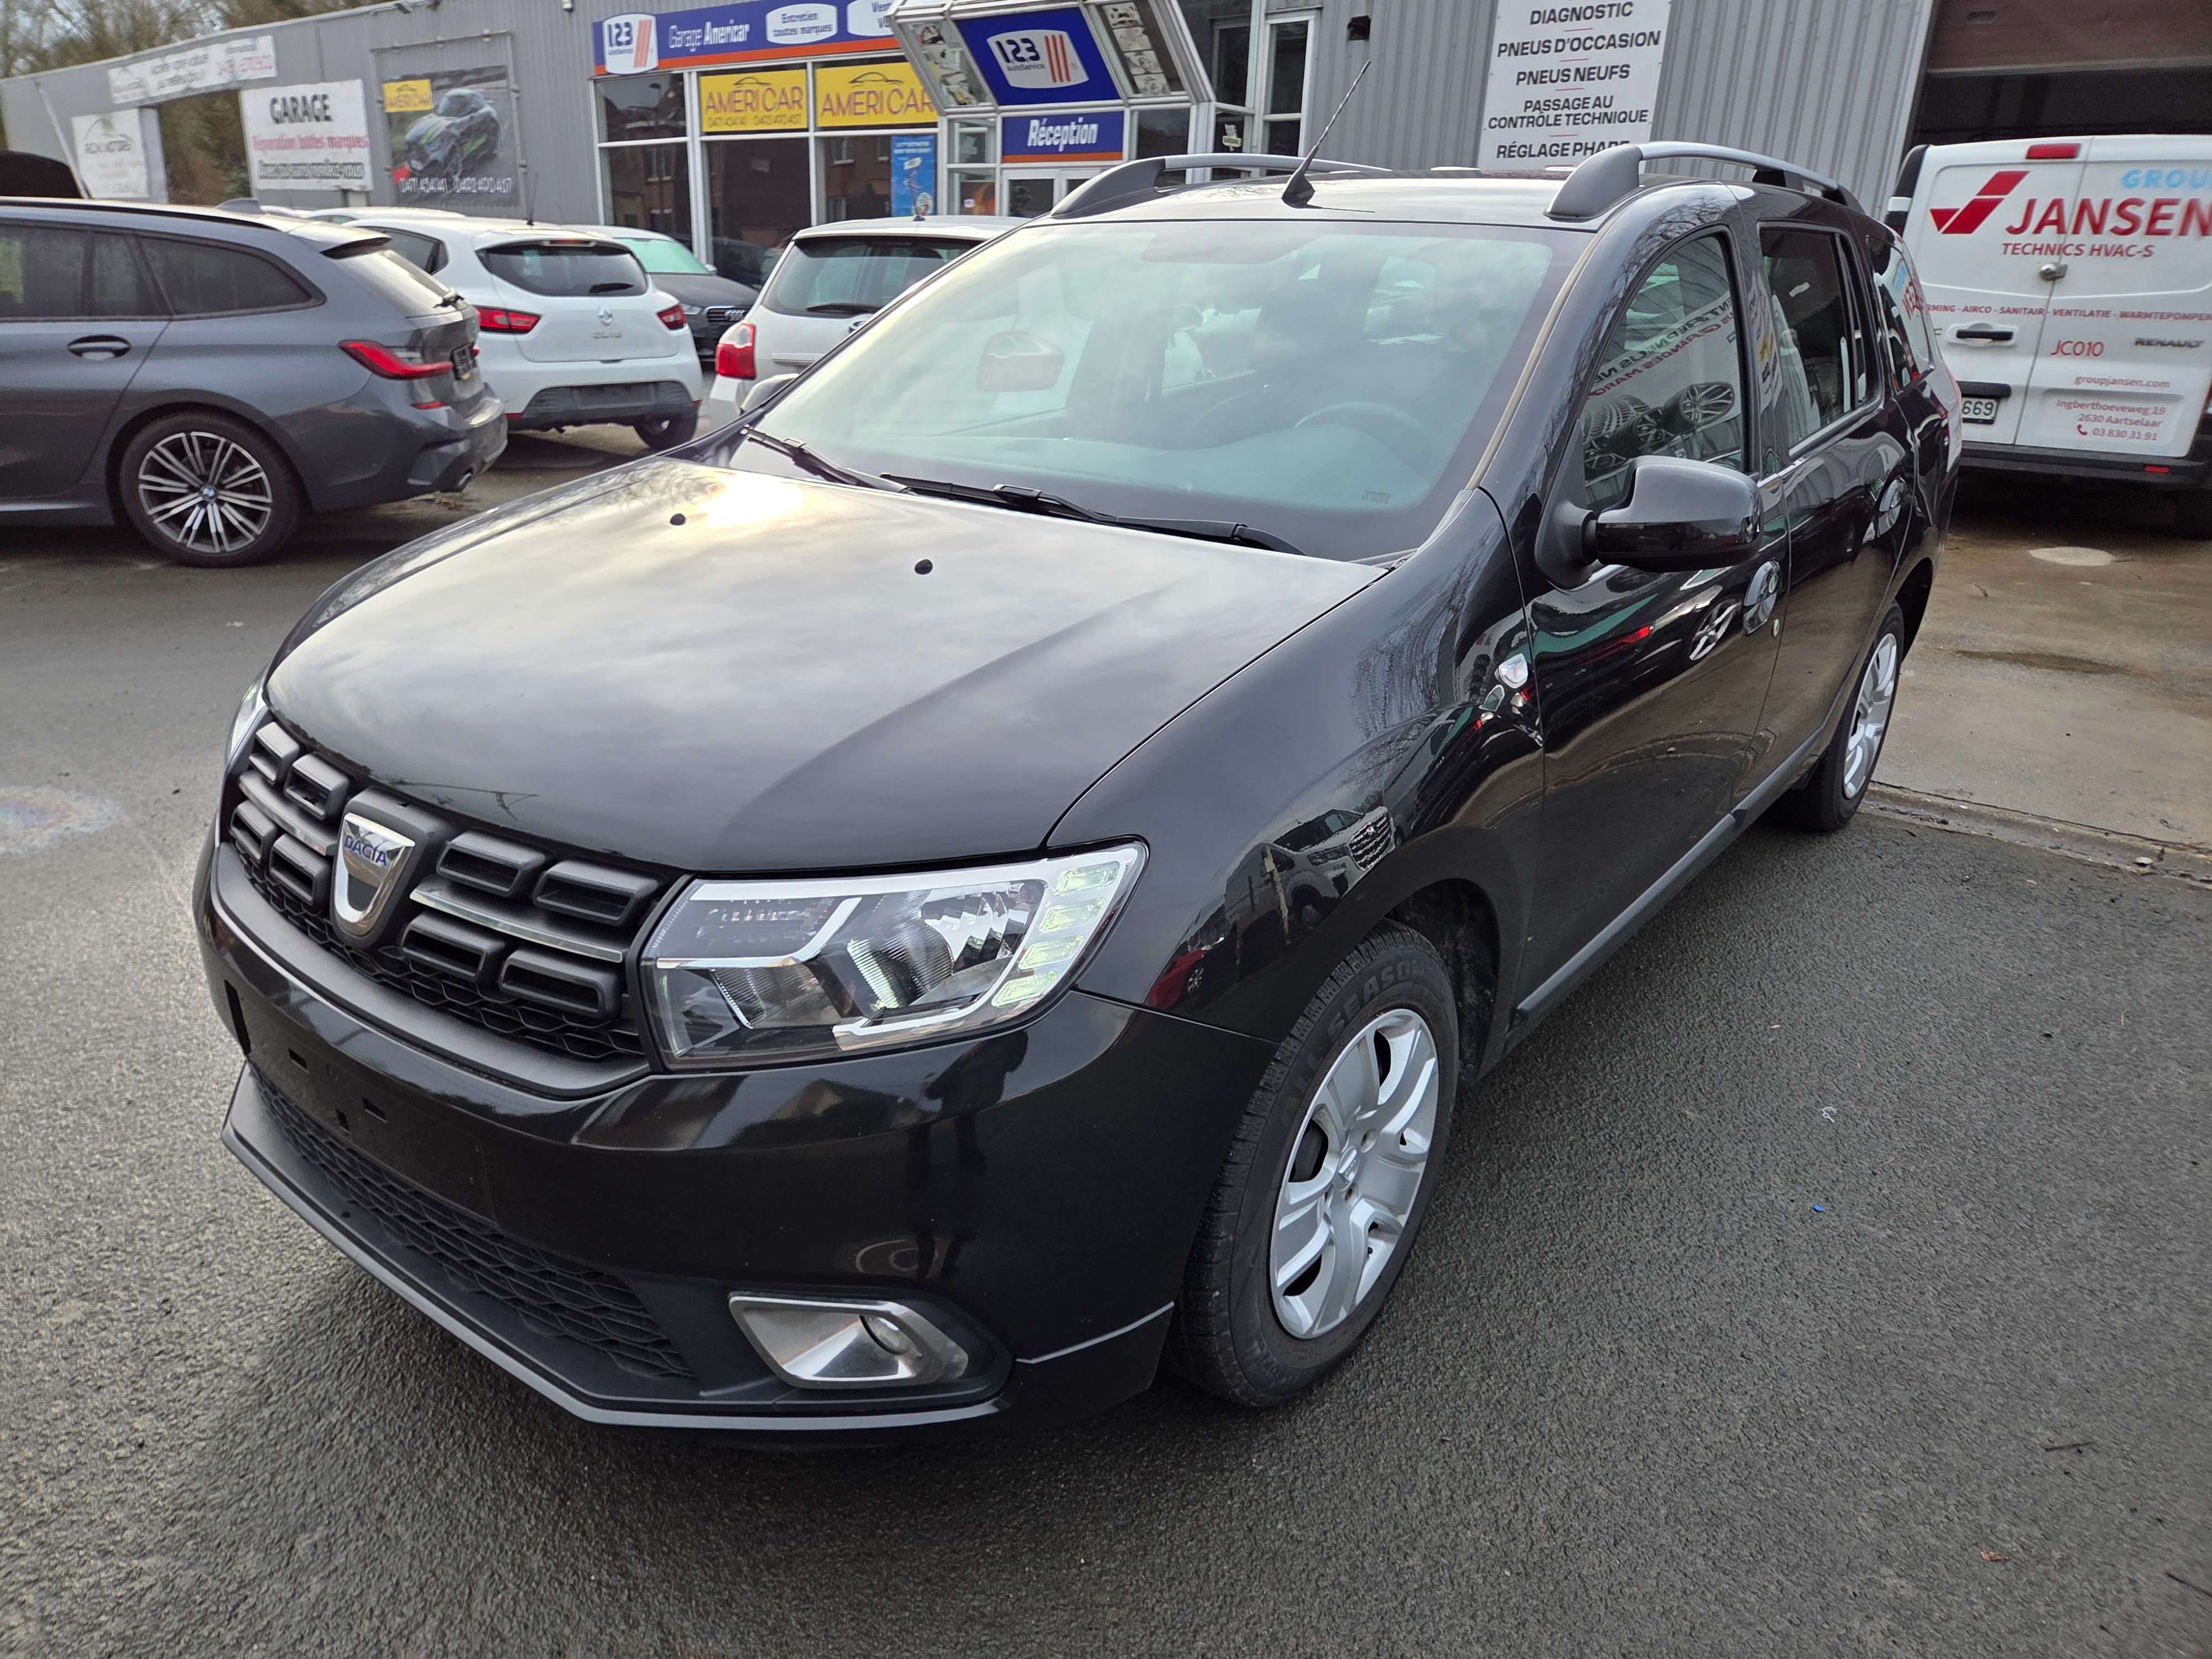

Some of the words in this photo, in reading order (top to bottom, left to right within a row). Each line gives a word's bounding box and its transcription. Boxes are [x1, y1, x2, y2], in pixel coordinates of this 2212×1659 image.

[1530, 2, 1634, 24] DIAGNOSTIC
[669, 25, 703, 52] Garage
[703, 19, 750, 45] Americar
[1497, 39, 1552, 57] PNEUS
[1554, 30, 1661, 53] D'OCCASION
[1516, 69, 1571, 86] PNEUS
[1573, 64, 1630, 82] NEUFS
[705, 86, 804, 113] AMERICAR
[1524, 97, 1590, 112] PASSAGE
[1592, 95, 1614, 109] AU
[270, 94, 333, 124] GARAGE
[1488, 112, 1561, 129] CONTRÔLE
[1565, 109, 1648, 126] TECHNIQUE
[1027, 117, 1098, 152] Réception
[1496, 141, 1570, 158] RÉGLAGE
[2006, 197, 2212, 236] JANSEN
[2001, 243, 2085, 256] TECHNICS
[2089, 244, 2155, 258] HVAC-S
[1963, 305, 1991, 314] AIRCO
[1999, 307, 2045, 315] SANITAIR
[2052, 309, 2112, 318] VENTILATIE
[2051, 340, 2105, 357] JC010
[2133, 337, 2205, 348] RENAULT
[2074, 376, 2171, 388] groupjansen.com
[1961, 400, 1994, 416] 669
[2057, 399, 2150, 416] Ingberthoeveweg
[2151, 406, 2166, 415] 19
[2078, 414, 2104, 422] 2630
[2105, 416, 2163, 427] Aartselaar
[2093, 428, 2106, 436] 03
[2107, 429, 2127, 438] 830
[2130, 431, 2142, 440] 31
[2144, 432, 2157, 441] 91
[344, 835, 387, 868] DACIA
[1327, 959, 1425, 1042] SEASON
